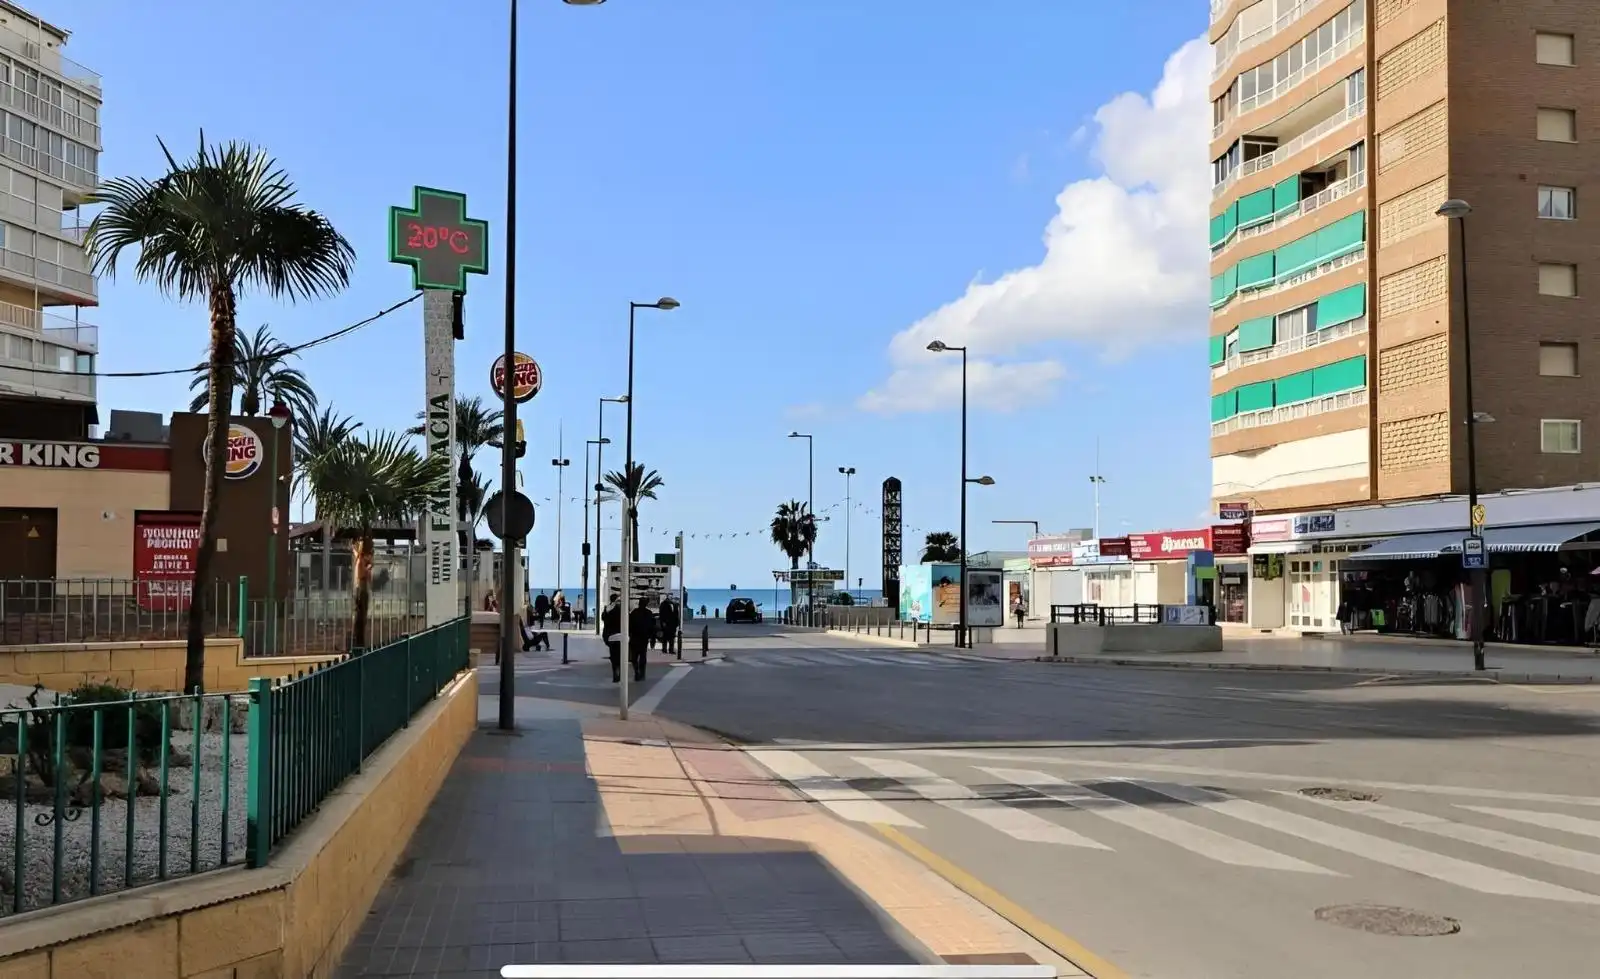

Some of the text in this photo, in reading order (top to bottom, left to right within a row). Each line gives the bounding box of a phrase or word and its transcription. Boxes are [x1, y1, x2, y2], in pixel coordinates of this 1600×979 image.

[22, 444, 100, 468] KING
[227, 446, 256, 461] ING
[430, 393, 450, 532] FARACIA
